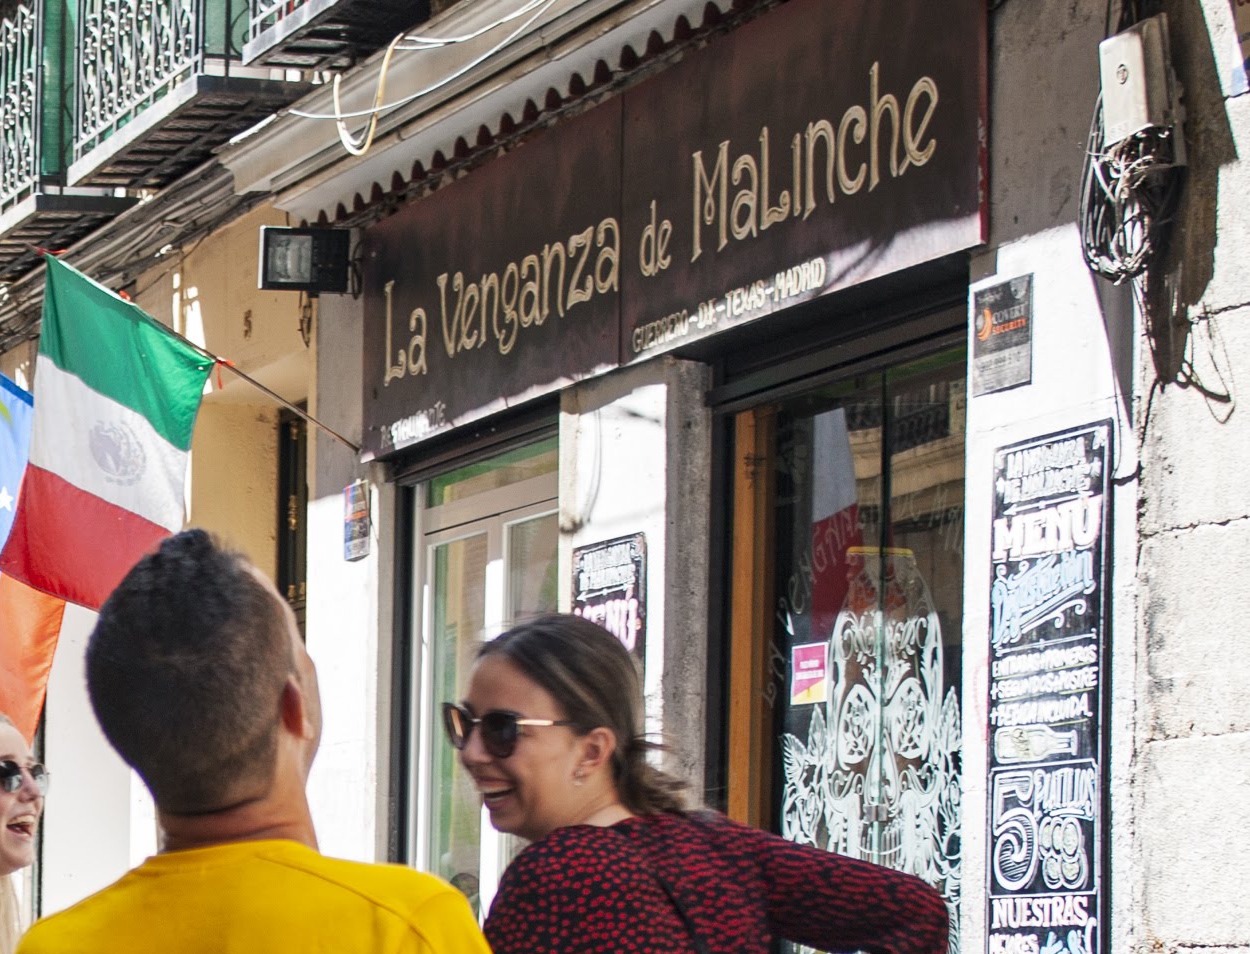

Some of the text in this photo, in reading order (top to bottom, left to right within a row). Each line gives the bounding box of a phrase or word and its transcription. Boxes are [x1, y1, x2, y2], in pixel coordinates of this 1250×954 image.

[384, 280, 428, 387] La
[437, 217, 620, 358] Venganza
[639, 200, 672, 277] de
[773, 257, 826, 302] MADRID
[991, 895, 1089, 929] NUESTRAS
